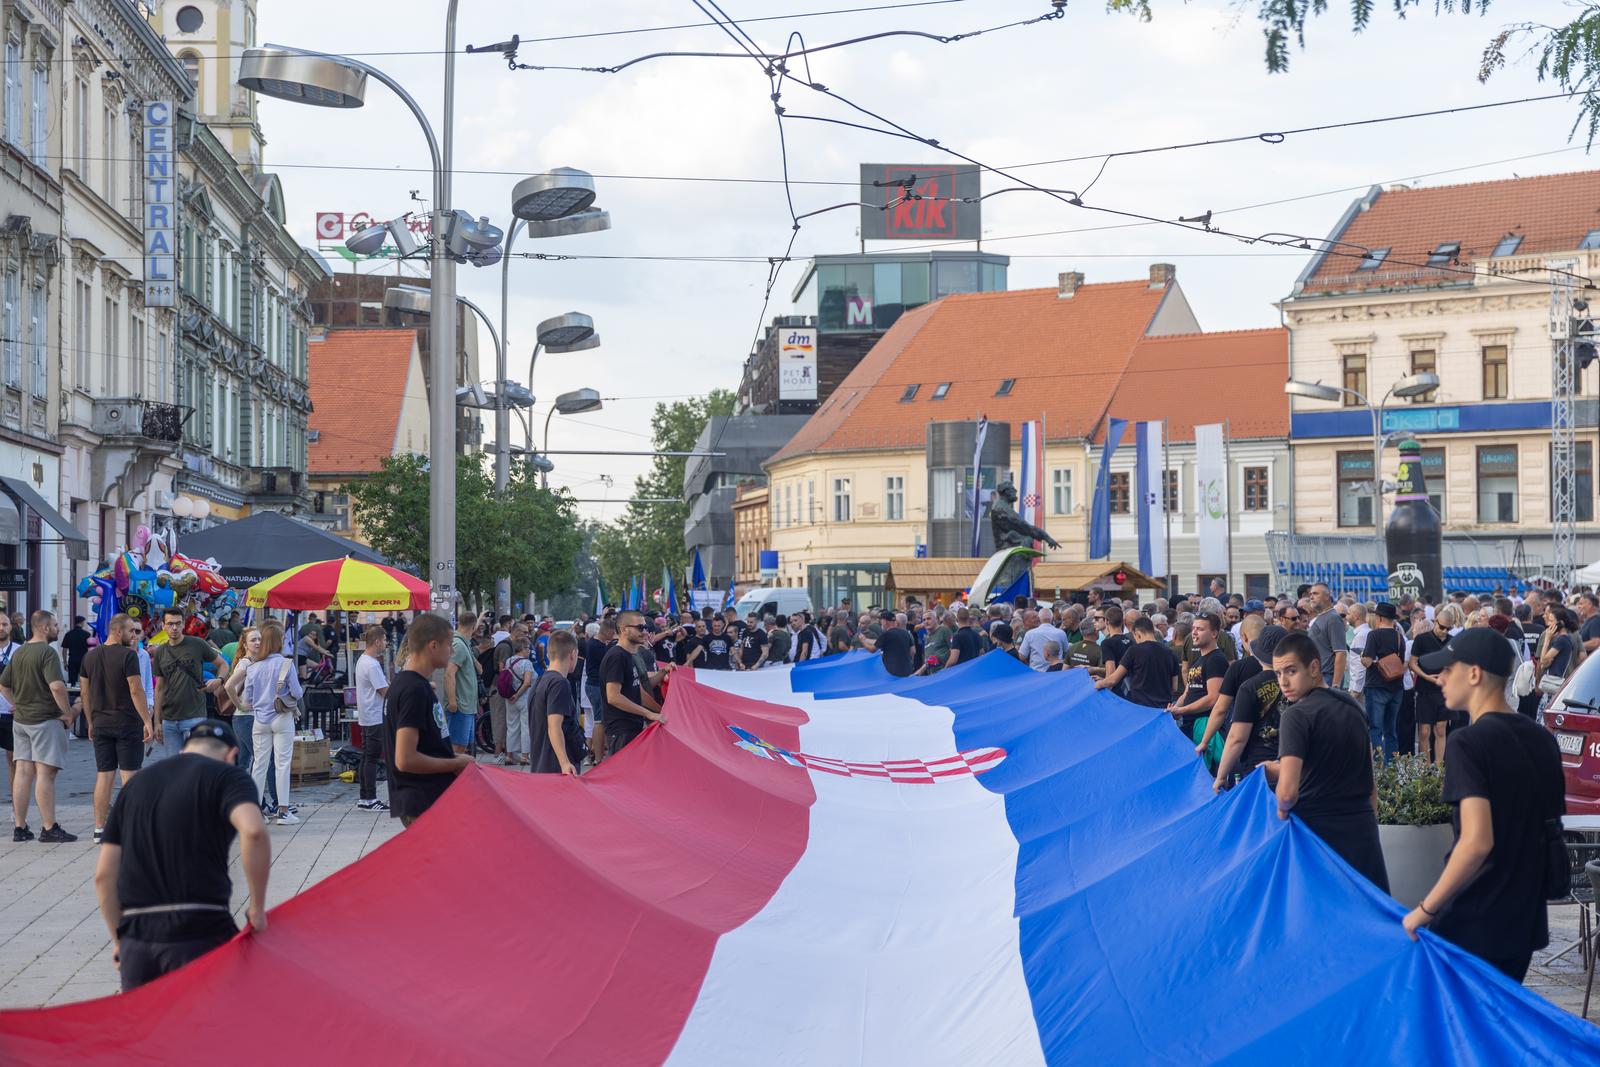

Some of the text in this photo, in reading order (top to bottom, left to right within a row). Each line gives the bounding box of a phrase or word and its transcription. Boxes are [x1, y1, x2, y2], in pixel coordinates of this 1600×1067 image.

[147, 103, 170, 279] CENTRAL
[787, 331, 810, 345] dm
[783, 369, 800, 377] PET
[225, 575, 259, 583] NATURAL
